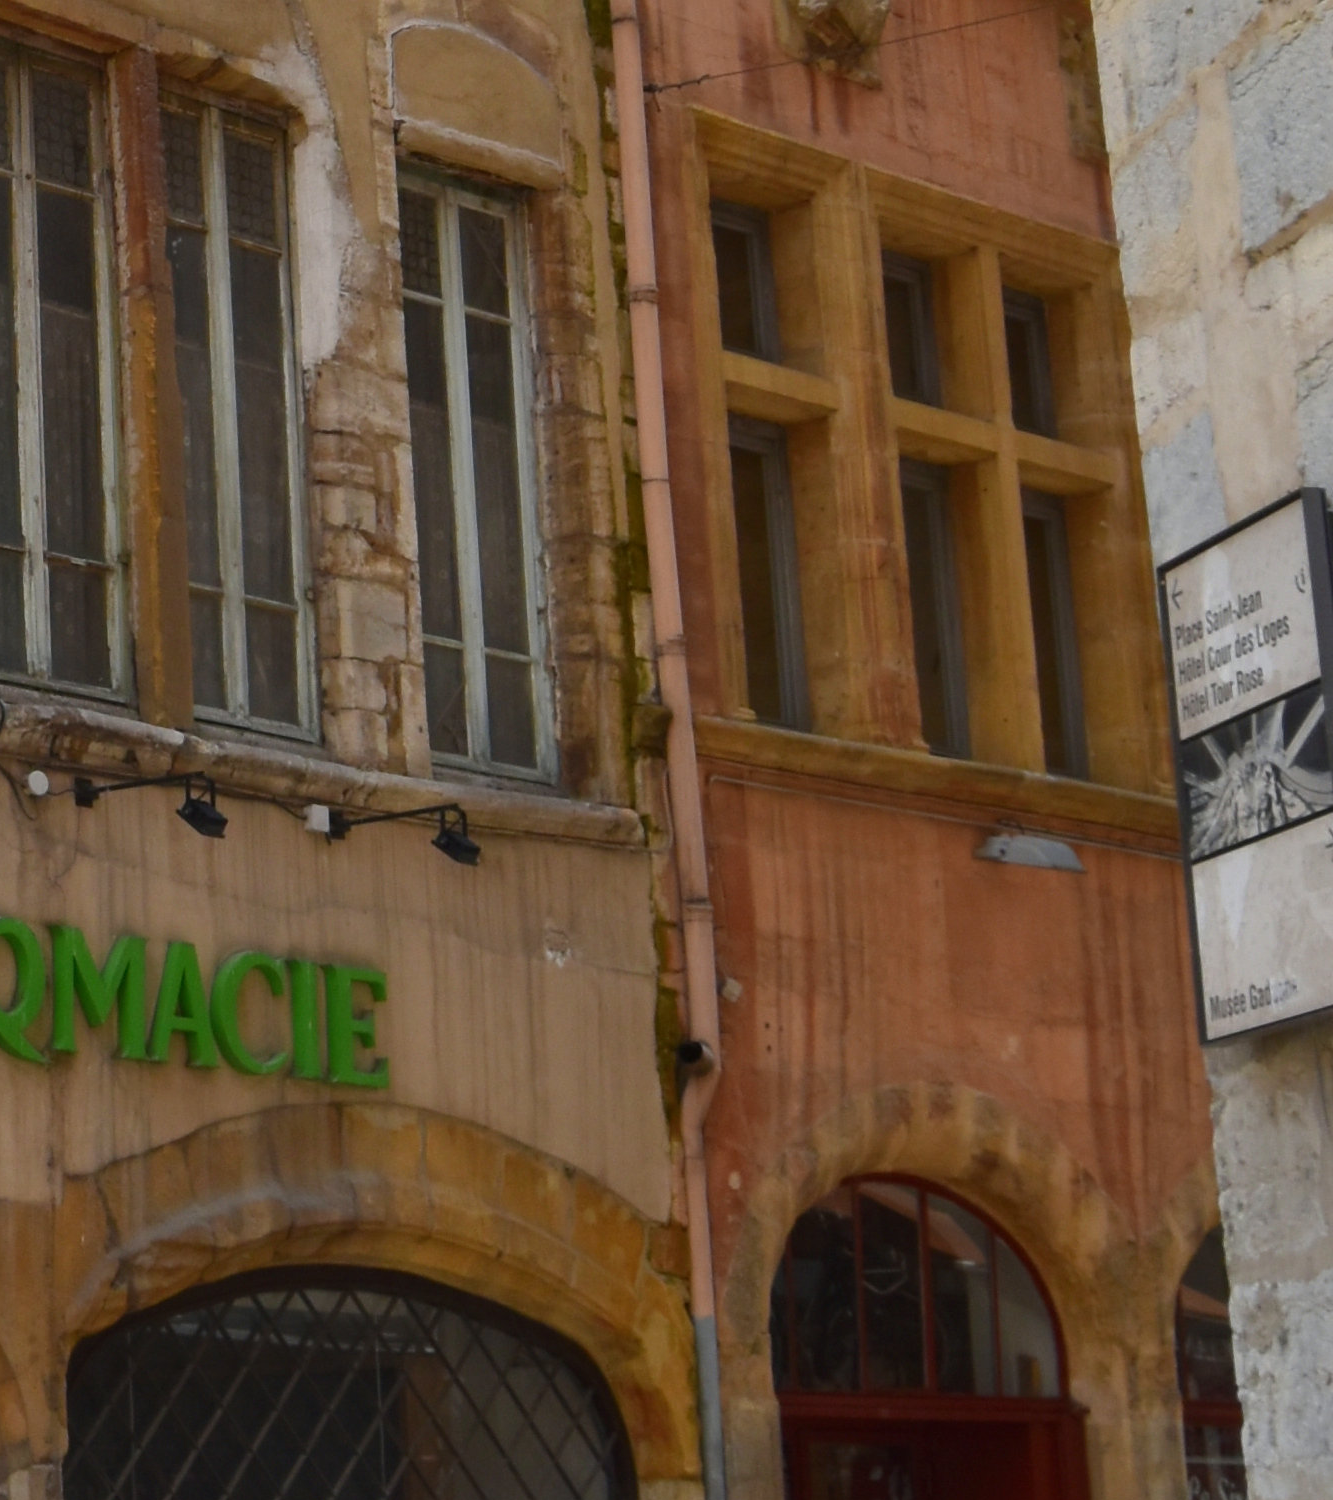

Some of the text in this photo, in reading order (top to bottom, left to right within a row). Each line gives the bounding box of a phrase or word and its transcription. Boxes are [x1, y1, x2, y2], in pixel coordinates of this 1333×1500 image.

[1174, 590, 1263, 650] Place Saint-Jean
[1178, 614, 1290, 686] Hôtel Cour des Loges
[1181, 666, 1265, 721] Hôtel Tour Rose
[1209, 988, 1247, 1022] Musée
